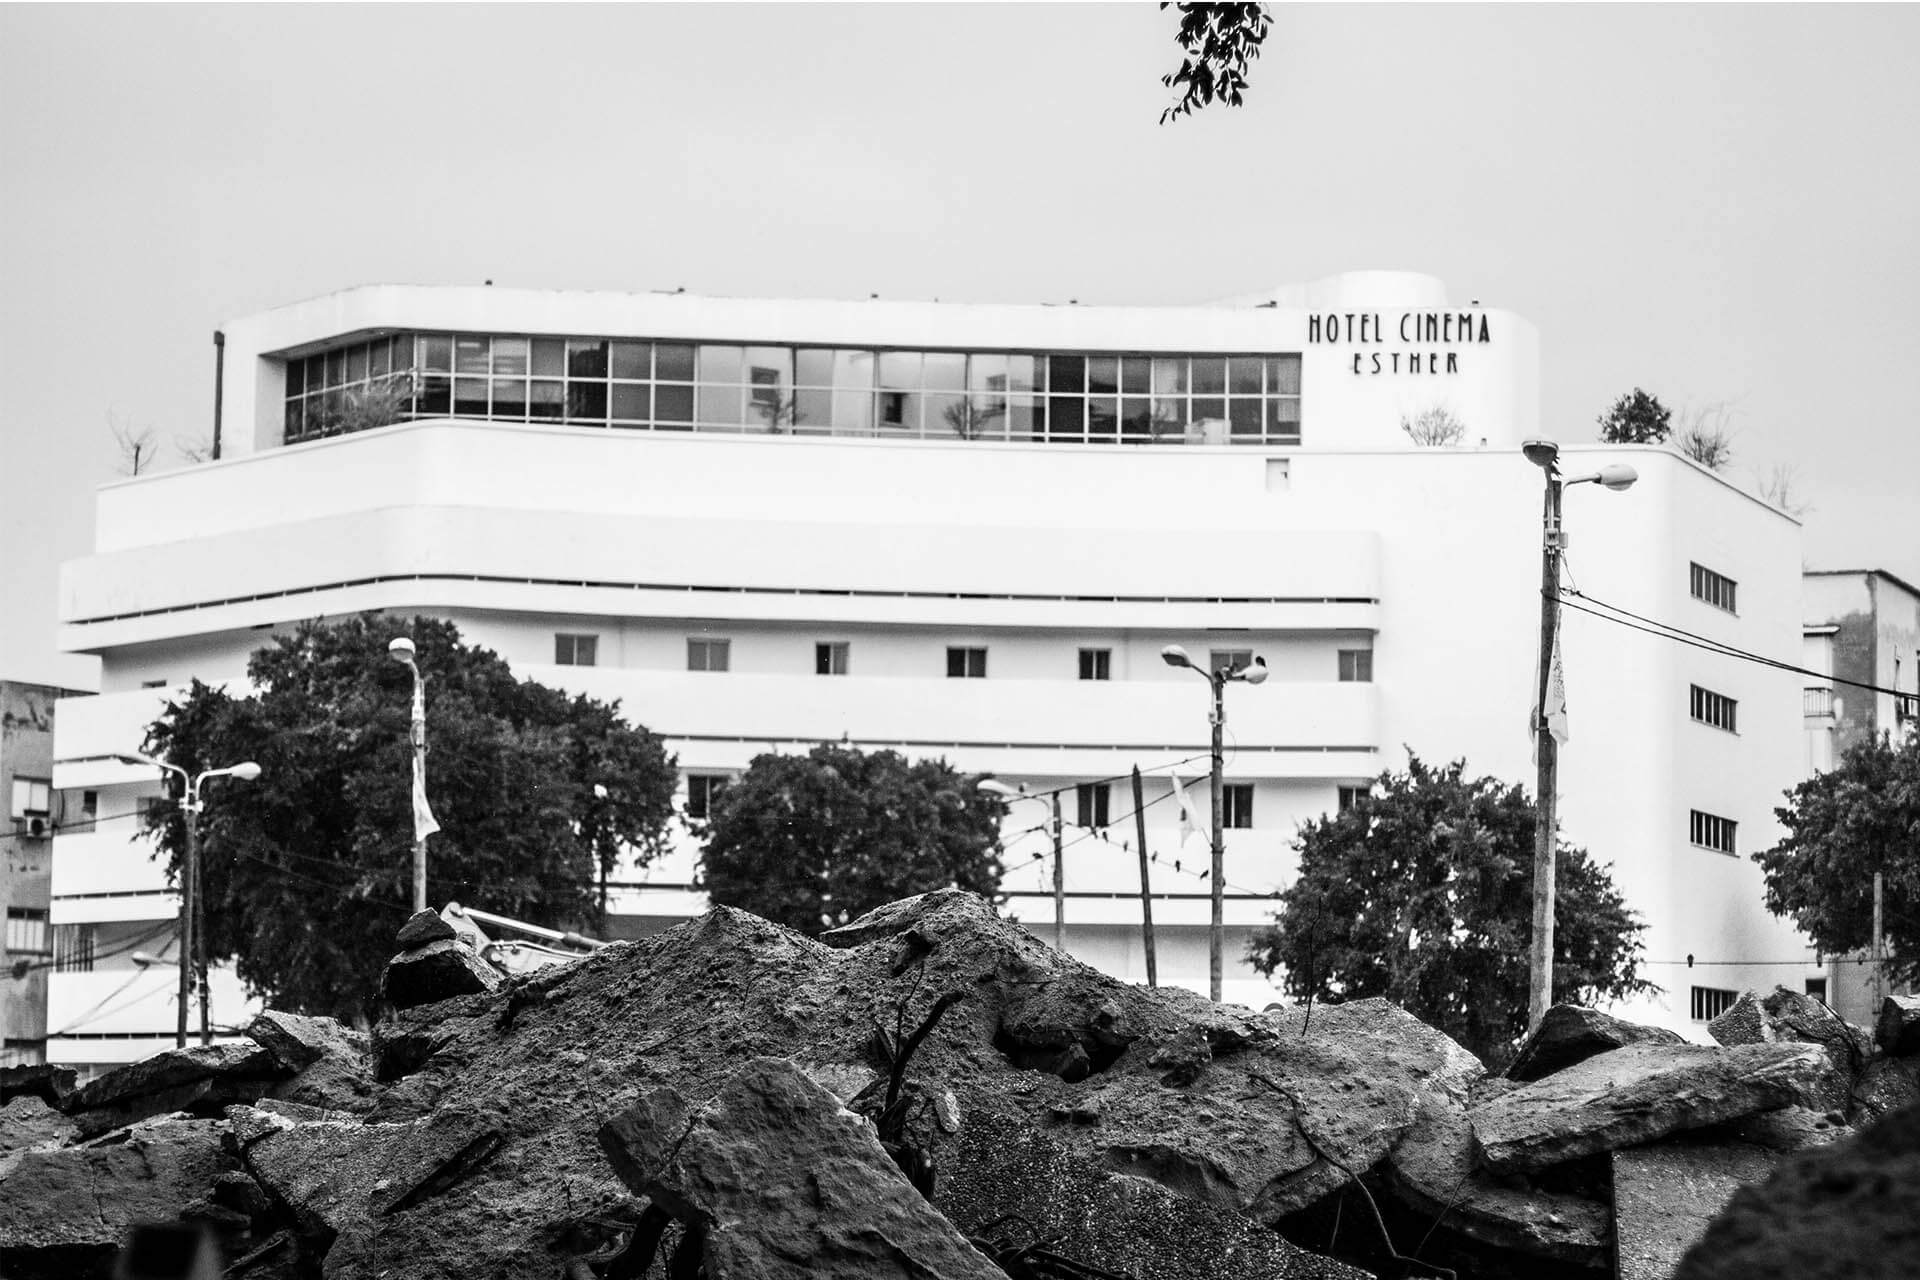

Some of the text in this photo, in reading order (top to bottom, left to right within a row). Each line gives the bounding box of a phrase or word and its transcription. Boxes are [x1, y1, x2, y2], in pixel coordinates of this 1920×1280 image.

[1309, 313, 1491, 343] HOTEL CINEMA
[1353, 352, 1458, 374] ESTHER
